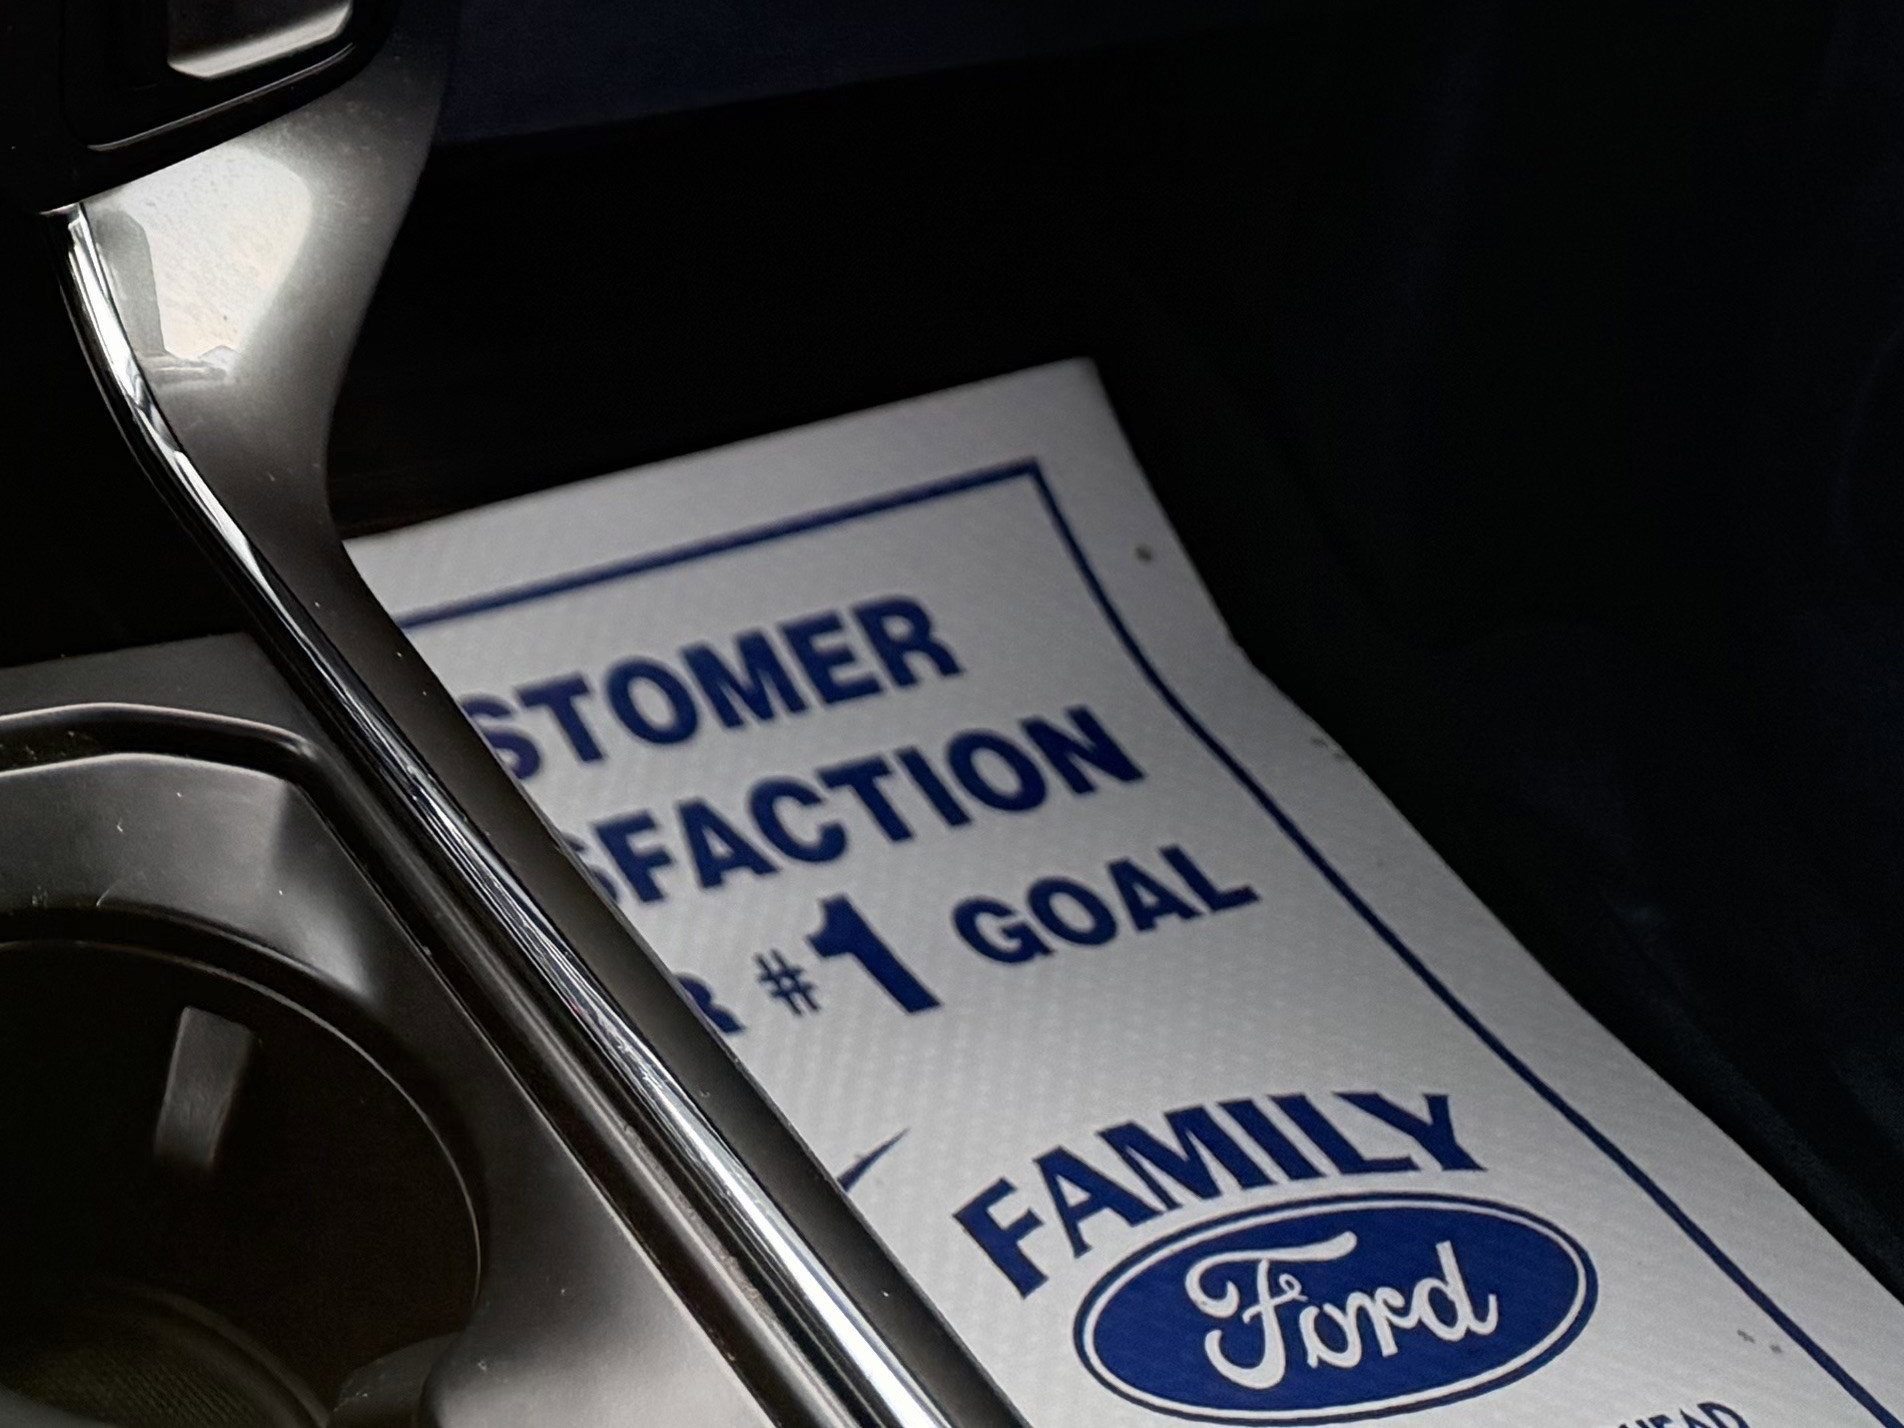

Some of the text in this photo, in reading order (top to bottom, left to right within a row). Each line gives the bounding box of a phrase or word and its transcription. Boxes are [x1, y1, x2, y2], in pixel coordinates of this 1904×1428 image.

[459, 592, 961, 782] STOMER
[753, 893, 943, 1016] #1
[951, 842, 1260, 968] GOAL
[952, 1091, 1490, 1302] FAMILY
[1183, 1230, 1500, 1391] Ford
